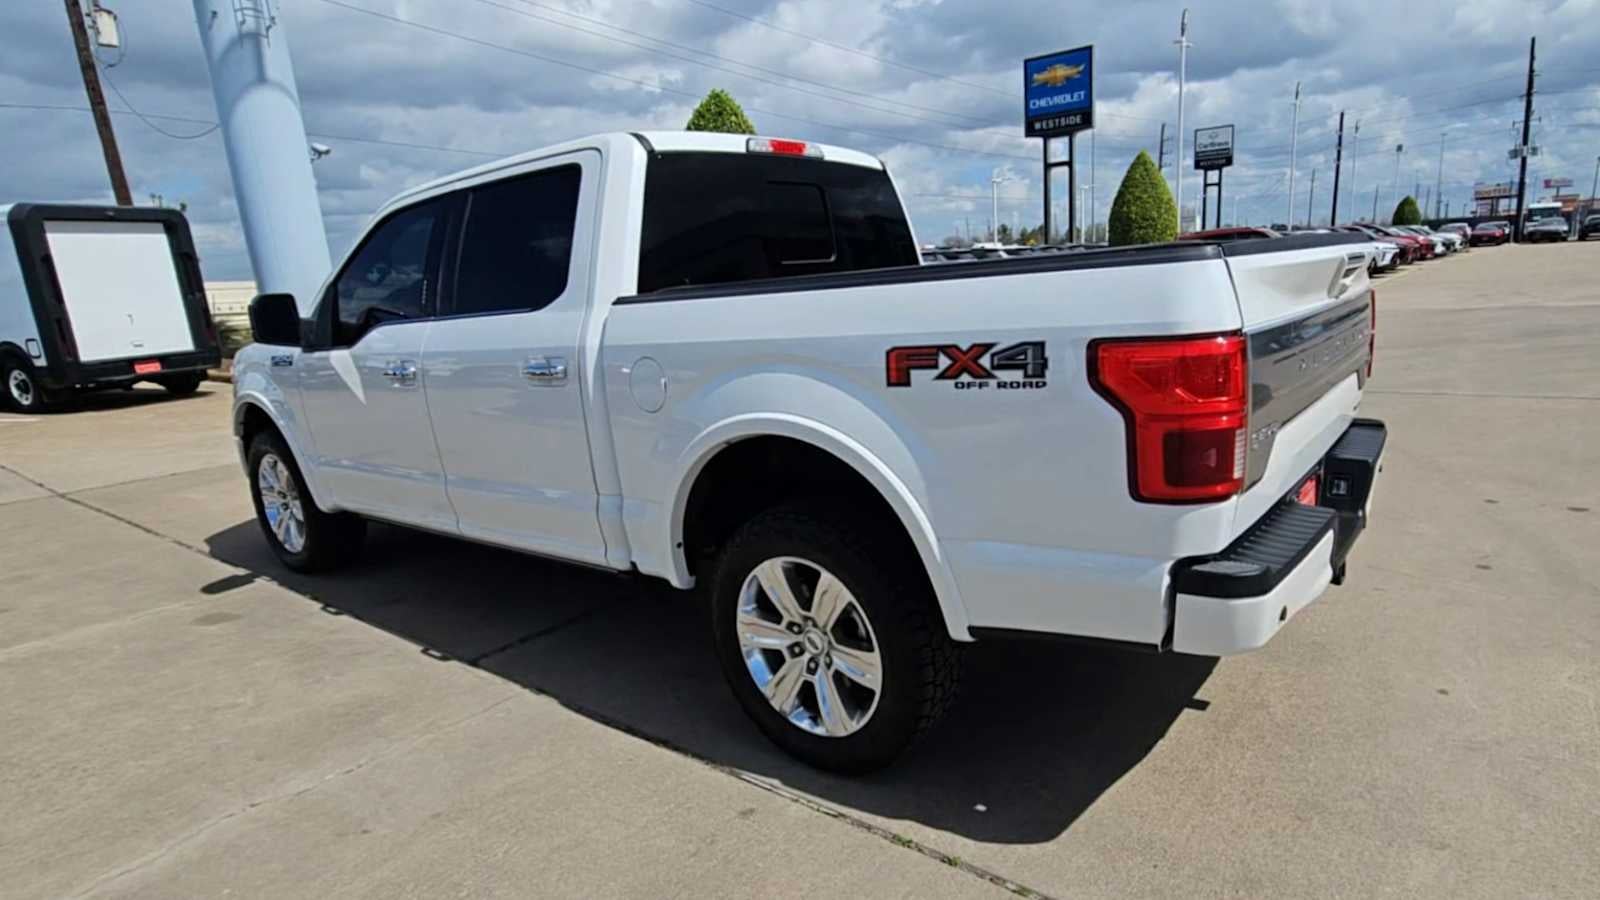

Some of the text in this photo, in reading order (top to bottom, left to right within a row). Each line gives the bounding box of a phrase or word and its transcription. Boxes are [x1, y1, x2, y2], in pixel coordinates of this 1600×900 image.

[1029, 90, 1086, 109] CHEVROLET
[1034, 114, 1082, 129] WESTSIDE
[886, 340, 1048, 388] FX4
[954, 380, 1047, 390] OFF ROAD
